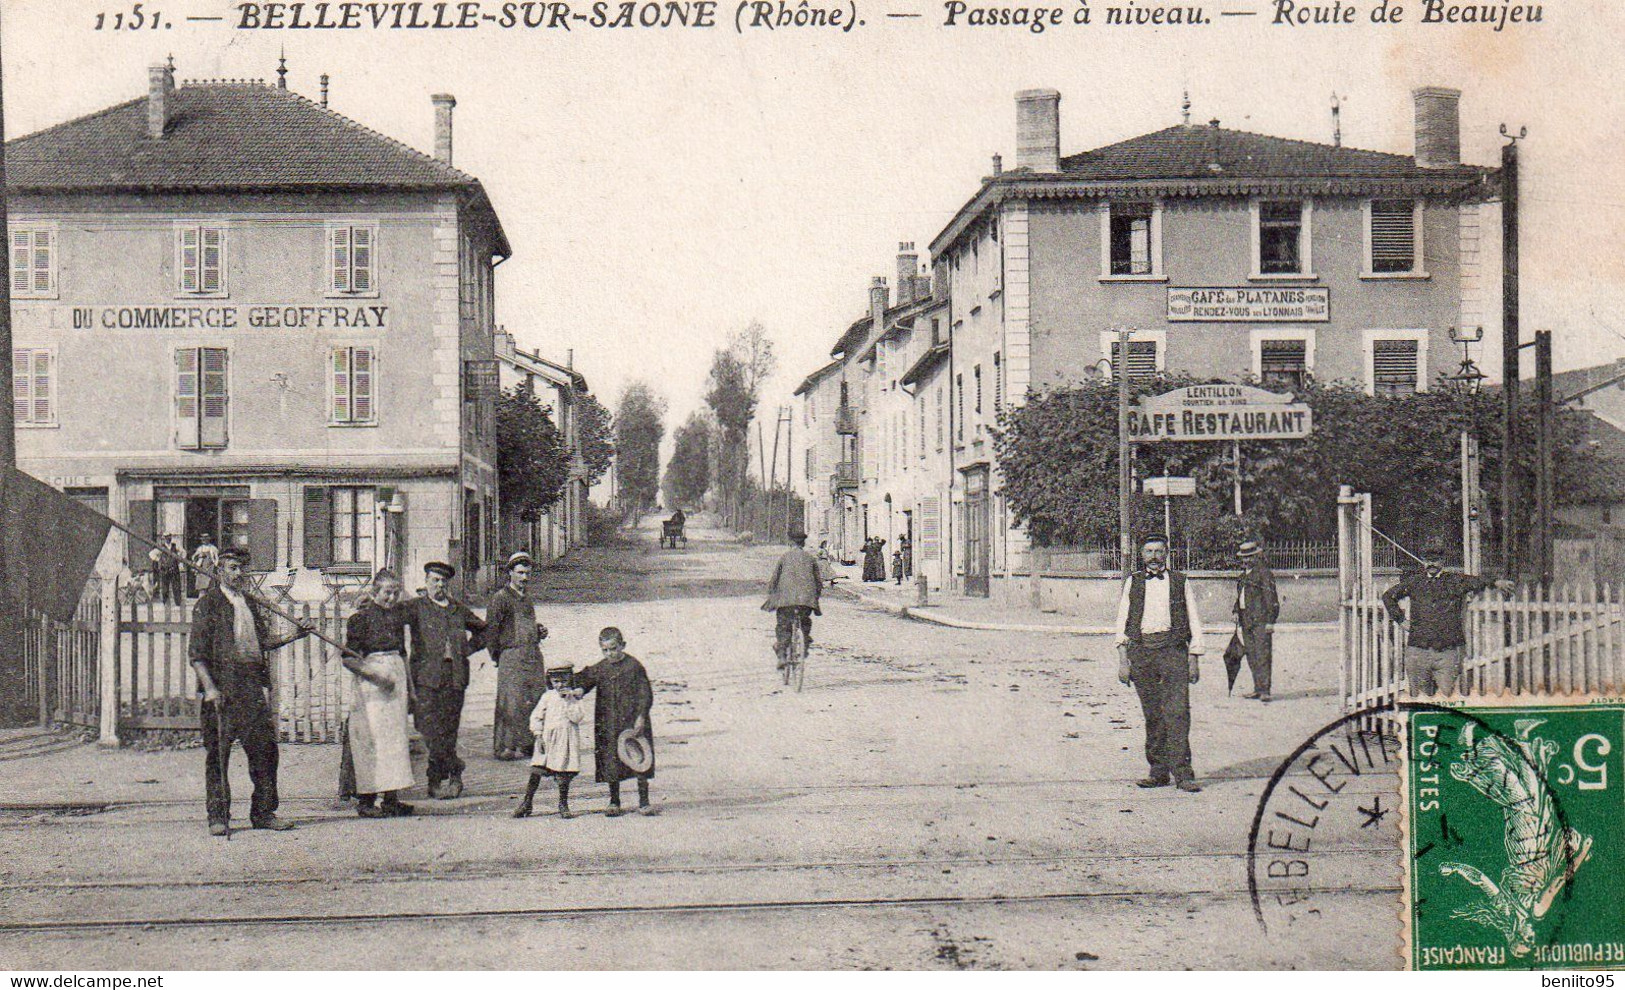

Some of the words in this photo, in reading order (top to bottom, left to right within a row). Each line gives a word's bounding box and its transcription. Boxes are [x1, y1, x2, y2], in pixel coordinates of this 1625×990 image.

[1236, 289, 1305, 305] PLATANES
[73, 307, 93, 329] DU
[101, 306, 237, 329] COMMERCE
[248, 305, 389, 328] GEOFFRAY
[1193, 306, 1250, 317] RENDEZ-VOUS
[1263, 306, 1304, 317] LYONNAIS
[1186, 387, 1242, 398] LENTILLON
[1419, 725, 1440, 812] POSTES
[1423, 944, 1506, 966] FRANÇAISE
